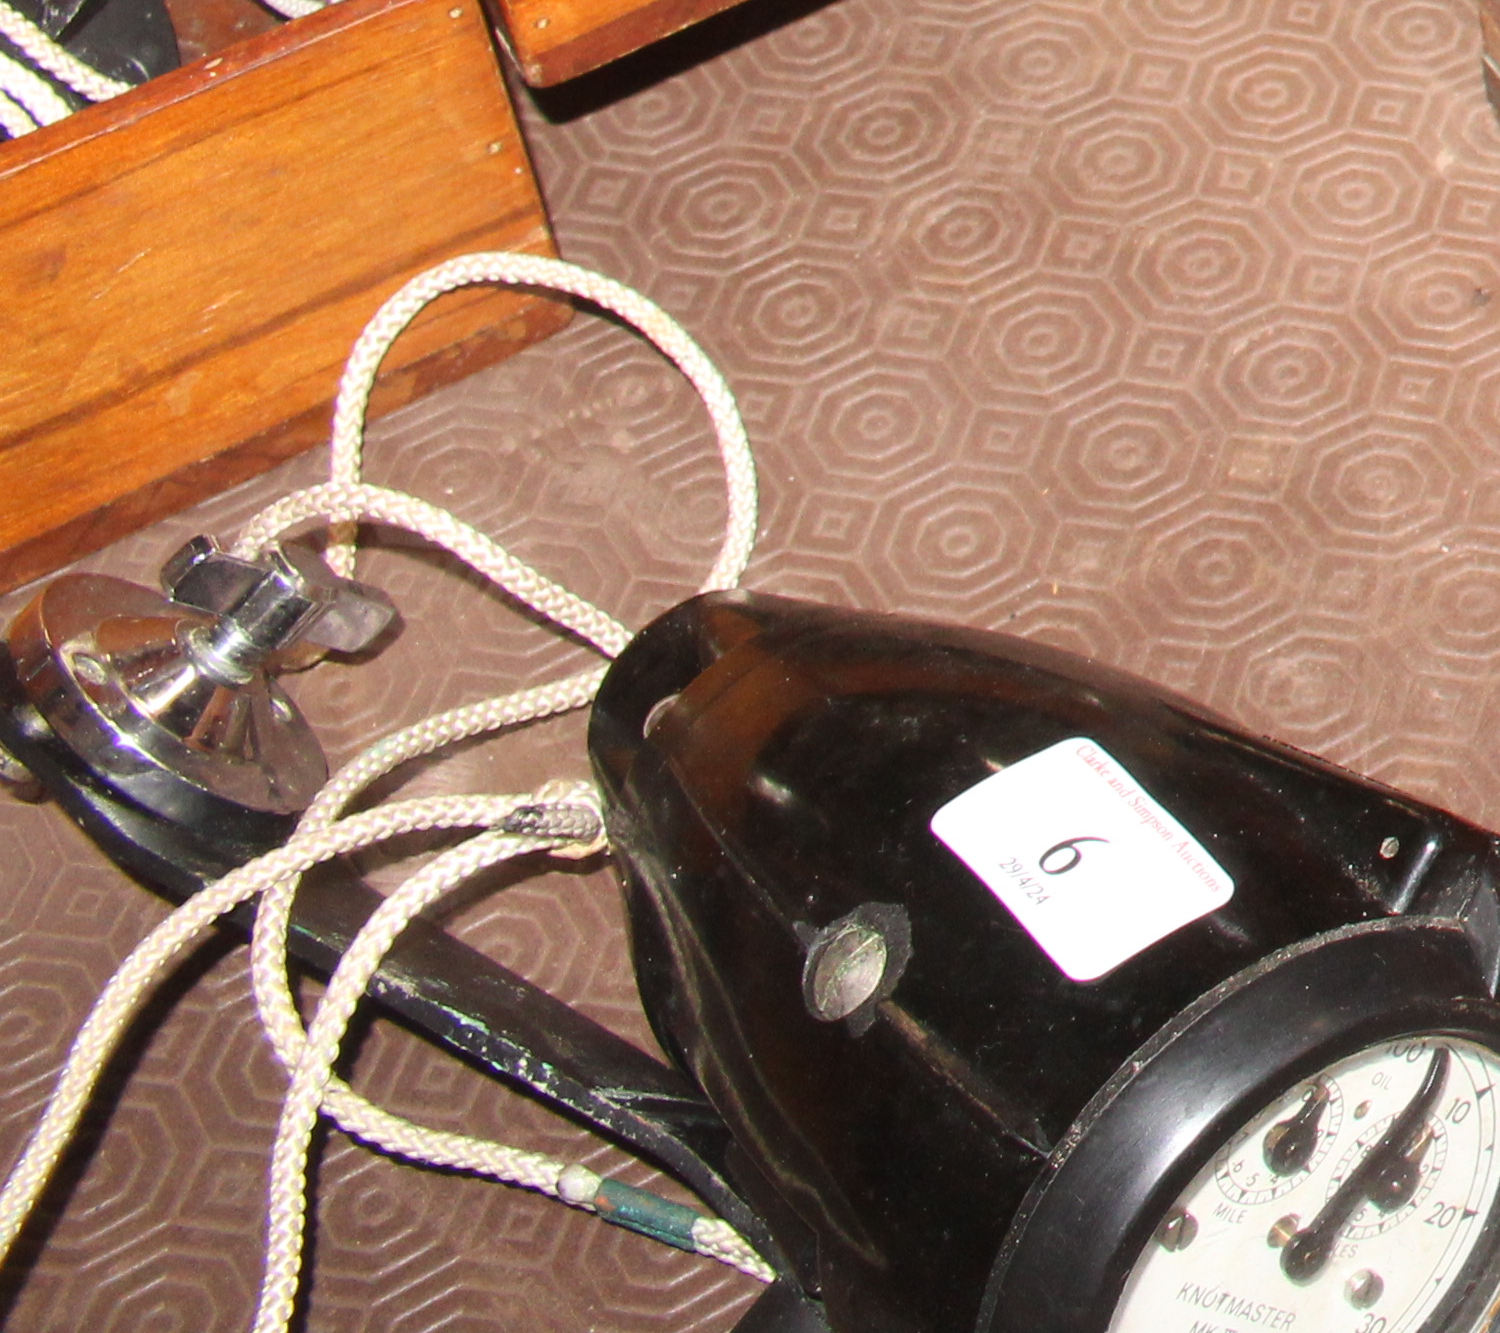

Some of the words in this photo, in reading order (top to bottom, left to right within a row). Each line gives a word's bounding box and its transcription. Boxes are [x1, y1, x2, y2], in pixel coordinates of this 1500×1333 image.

[1075, 744, 1110, 778] Clarke
[1107, 775, 1133, 799] and
[1127, 794, 1174, 841] Simpson
[1171, 840, 1222, 894] Auctions
[1038, 836, 1111, 876] 6
[998, 856, 1052, 907] 29/4/24
[1371, 1071, 1392, 1091] OIL
[1444, 1097, 1472, 1124] 10
[1212, 1202, 1248, 1225] MILE
[1424, 1201, 1458, 1229] 20
[1176, 1281, 1297, 1331] KNOTMASTER
